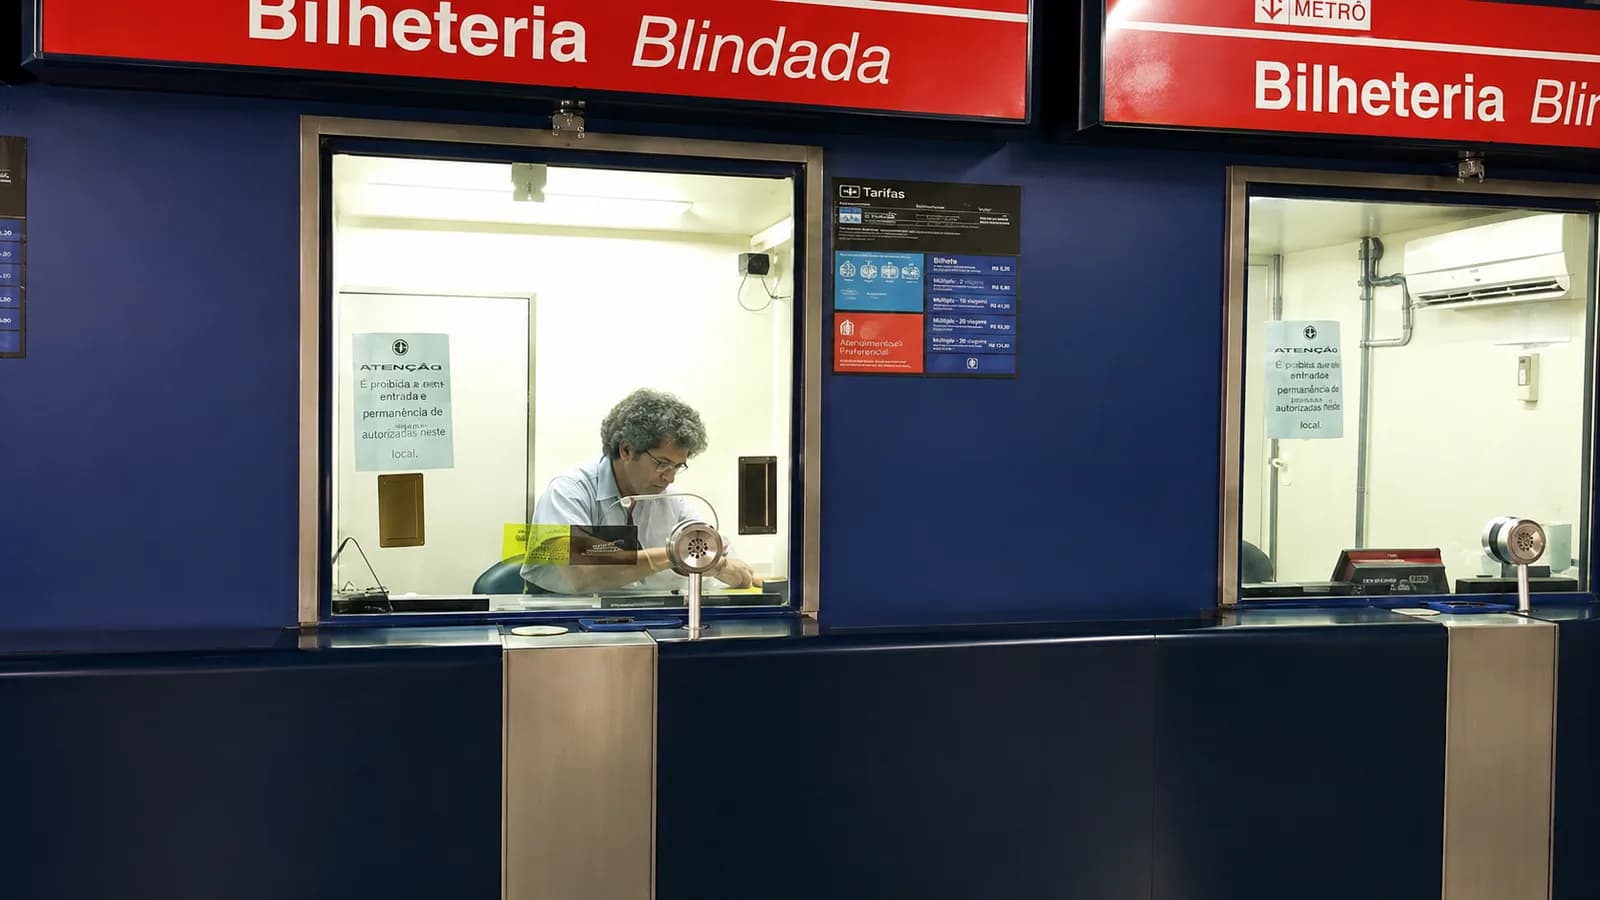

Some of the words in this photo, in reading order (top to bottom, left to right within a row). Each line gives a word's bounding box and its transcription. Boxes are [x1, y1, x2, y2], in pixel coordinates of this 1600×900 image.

[1295, 0, 1366, 21] METRÔ
[248, 0, 588, 63] Bilheteria
[631, 14, 892, 85] Blindada
[1254, 60, 1505, 123] Bilheteria
[862, 187, 905, 199] Tarifas
[1274, 346, 1338, 354] ATENÇÃO
[360, 362, 442, 372] ATENÇÃO
[370, 380, 411, 391] proibida
[1277, 385, 1330, 396] permanência
[1331, 385, 1340, 393] de
[380, 392, 419, 401] entrada
[420, 392, 428, 401] e
[363, 408, 428, 420] permanência
[431, 407, 444, 416] de
[1275, 404, 1322, 412] autorizadas
[362, 428, 418, 440] autorizadas
[420, 427, 446, 437] neste
[391, 449, 419, 460] local.
